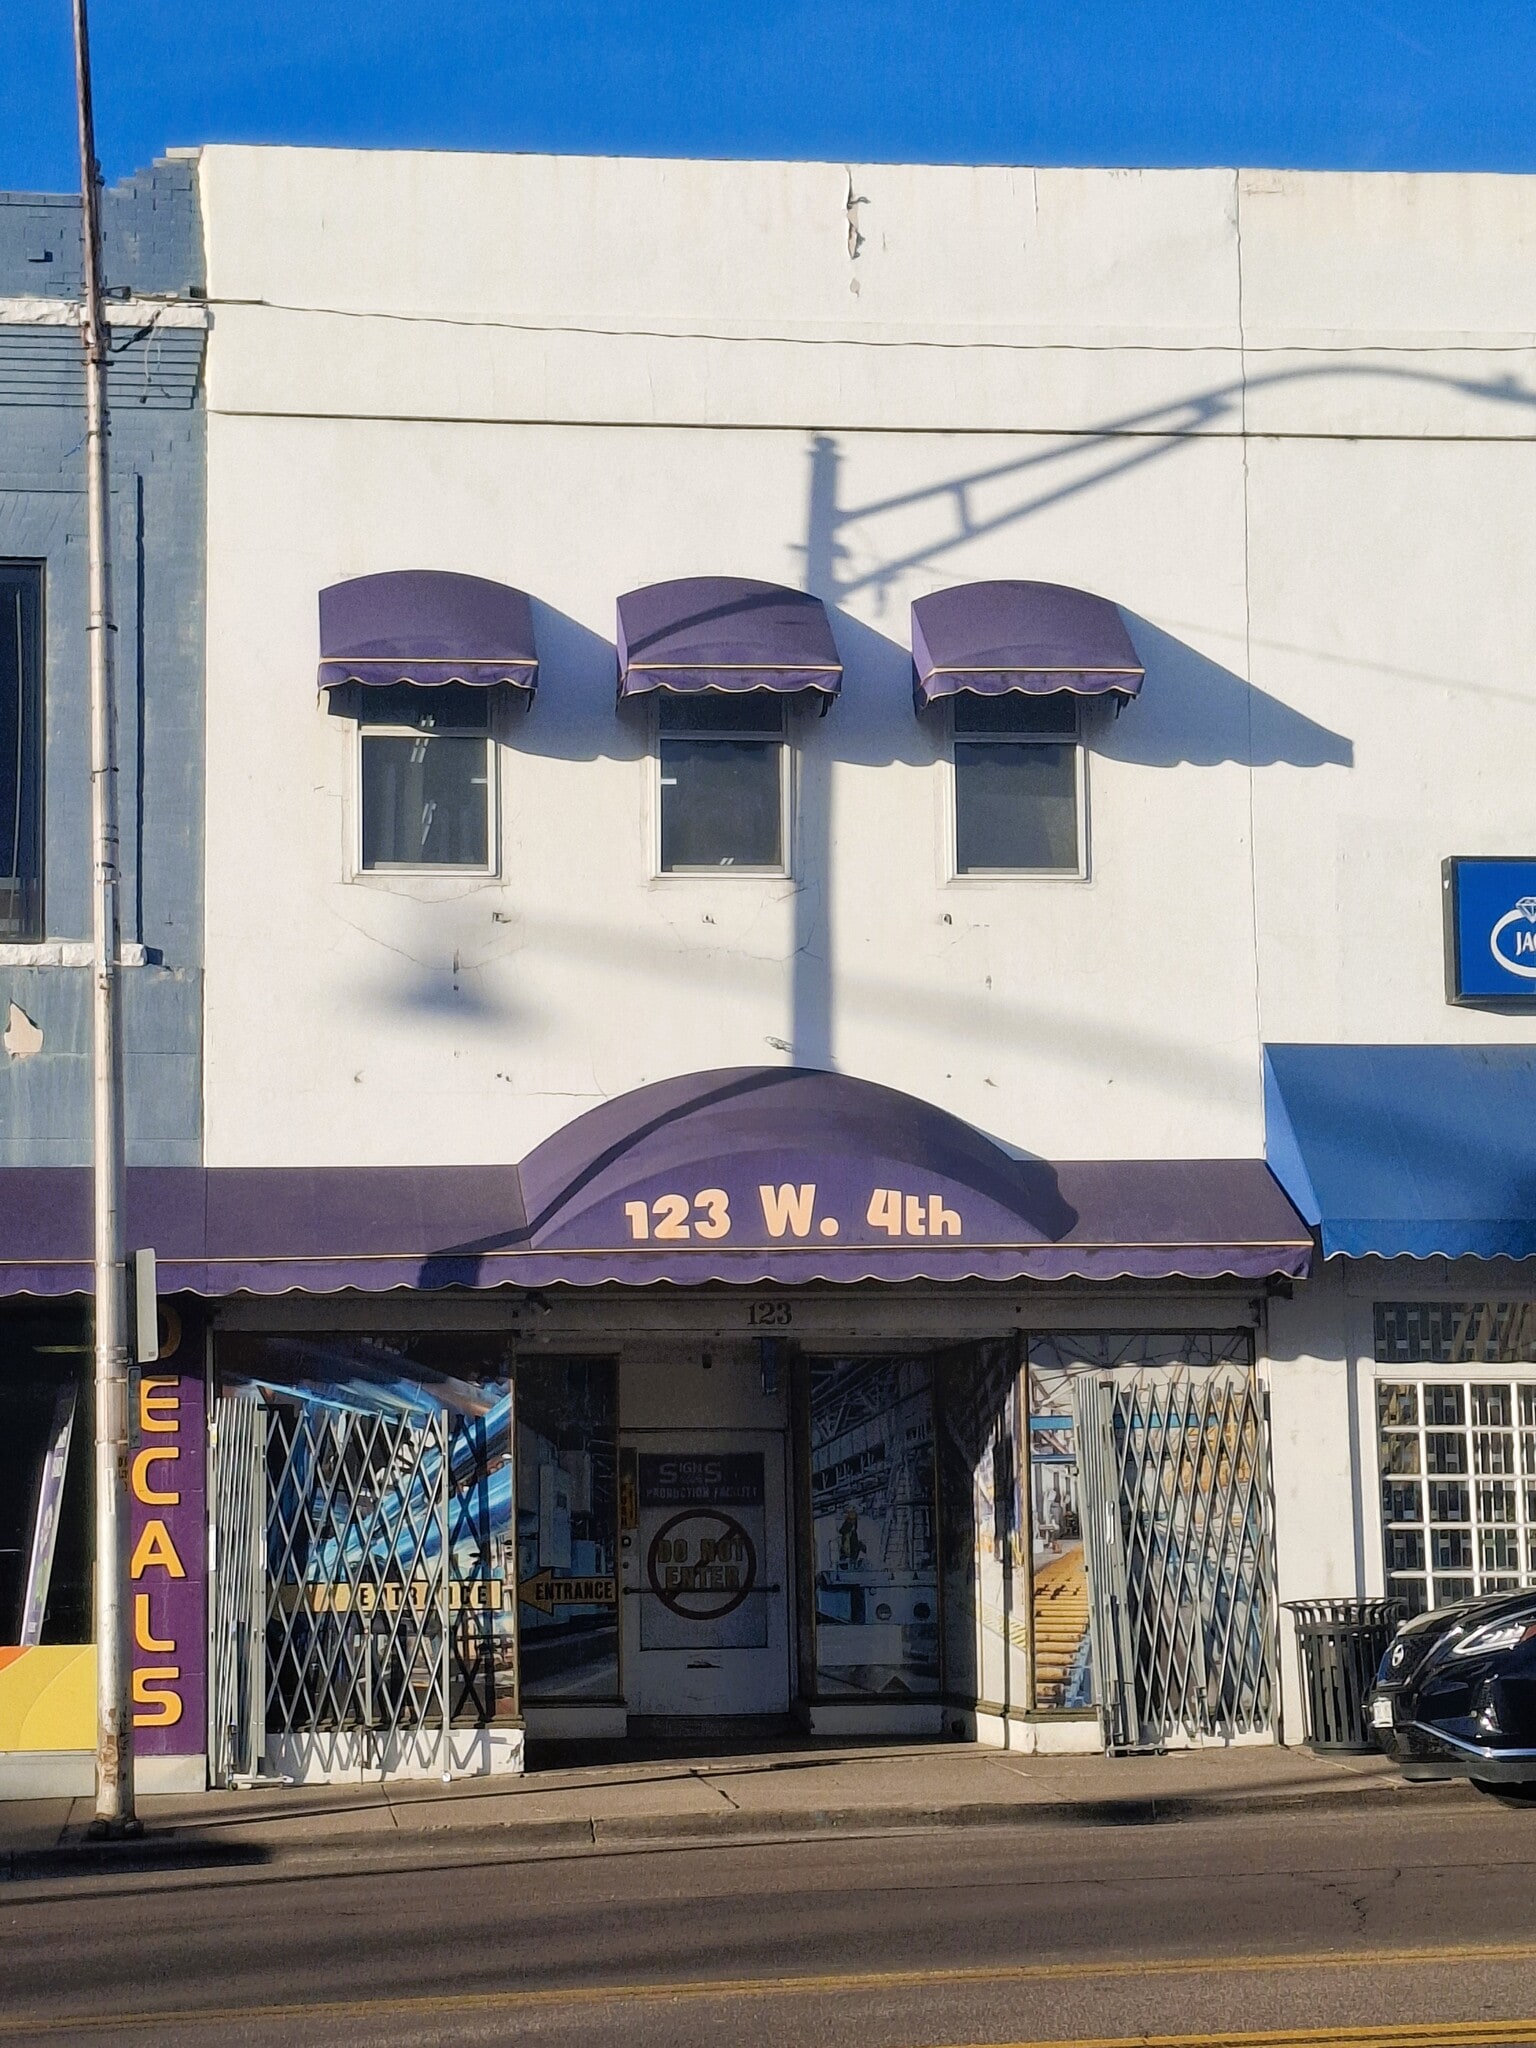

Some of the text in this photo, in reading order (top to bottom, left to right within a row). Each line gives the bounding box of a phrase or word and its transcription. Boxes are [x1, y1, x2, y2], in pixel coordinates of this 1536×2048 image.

[624, 1183, 963, 1240] 123 W. 4th
[747, 1302, 793, 1326] 123
[658, 1538, 745, 1563] DO NOT
[535, 1580, 613, 1601] ENTRANCE
[665, 1565, 740, 1592] ENTER
[360, 1585, 487, 1606] ETRCE
